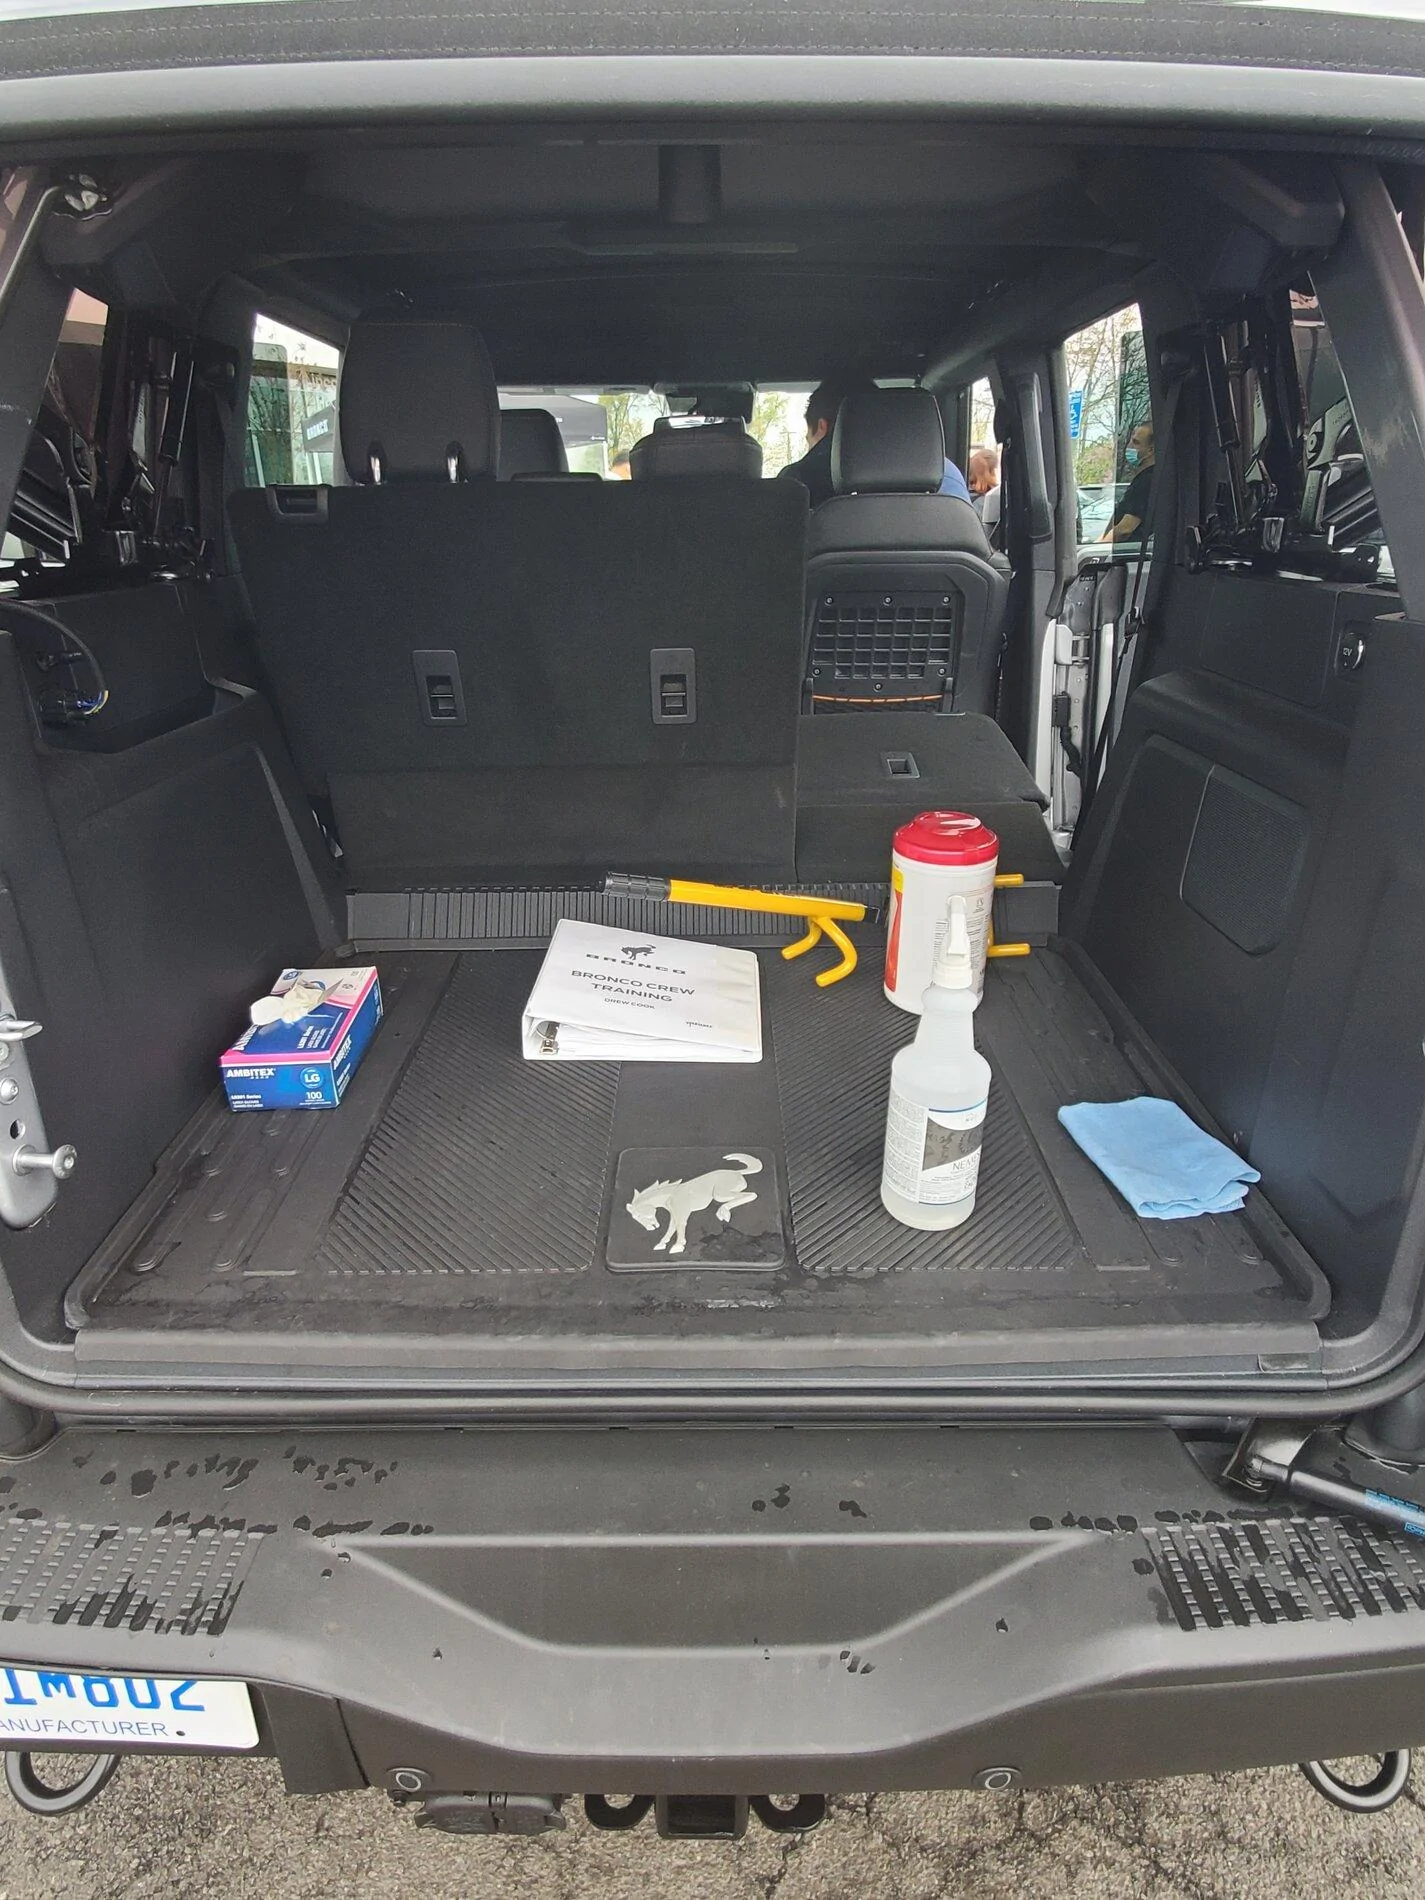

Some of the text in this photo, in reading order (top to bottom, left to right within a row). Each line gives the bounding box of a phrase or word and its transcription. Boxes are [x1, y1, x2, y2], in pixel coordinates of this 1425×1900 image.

[586, 954, 686, 975] BRONCO
[571, 970, 696, 996] BRONCO CREW
[591, 983, 673, 1002] TRAINING
[226, 1068, 275, 1077] AMBITEX
[304, 1073, 320, 1082] LG
[306, 1091, 323, 1100] 100
